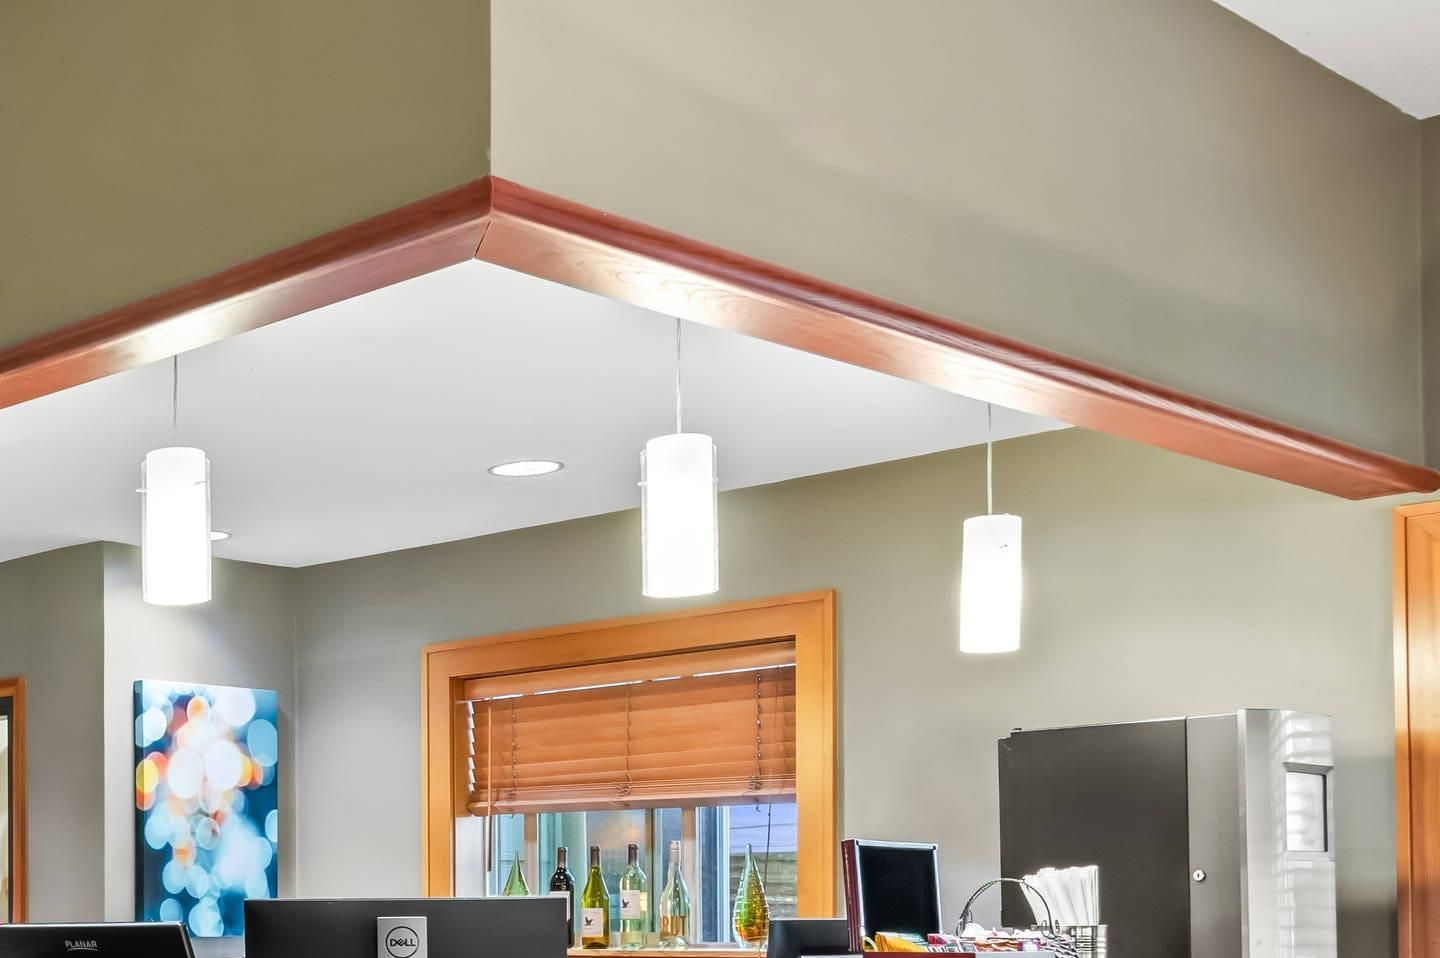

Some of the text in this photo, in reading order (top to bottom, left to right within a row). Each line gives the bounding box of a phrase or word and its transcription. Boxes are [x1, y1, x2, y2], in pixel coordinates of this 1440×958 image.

[660, 915, 687, 937] RUT
[64, 940, 98, 948] PLANAR
[390, 938, 416, 947] DELL
